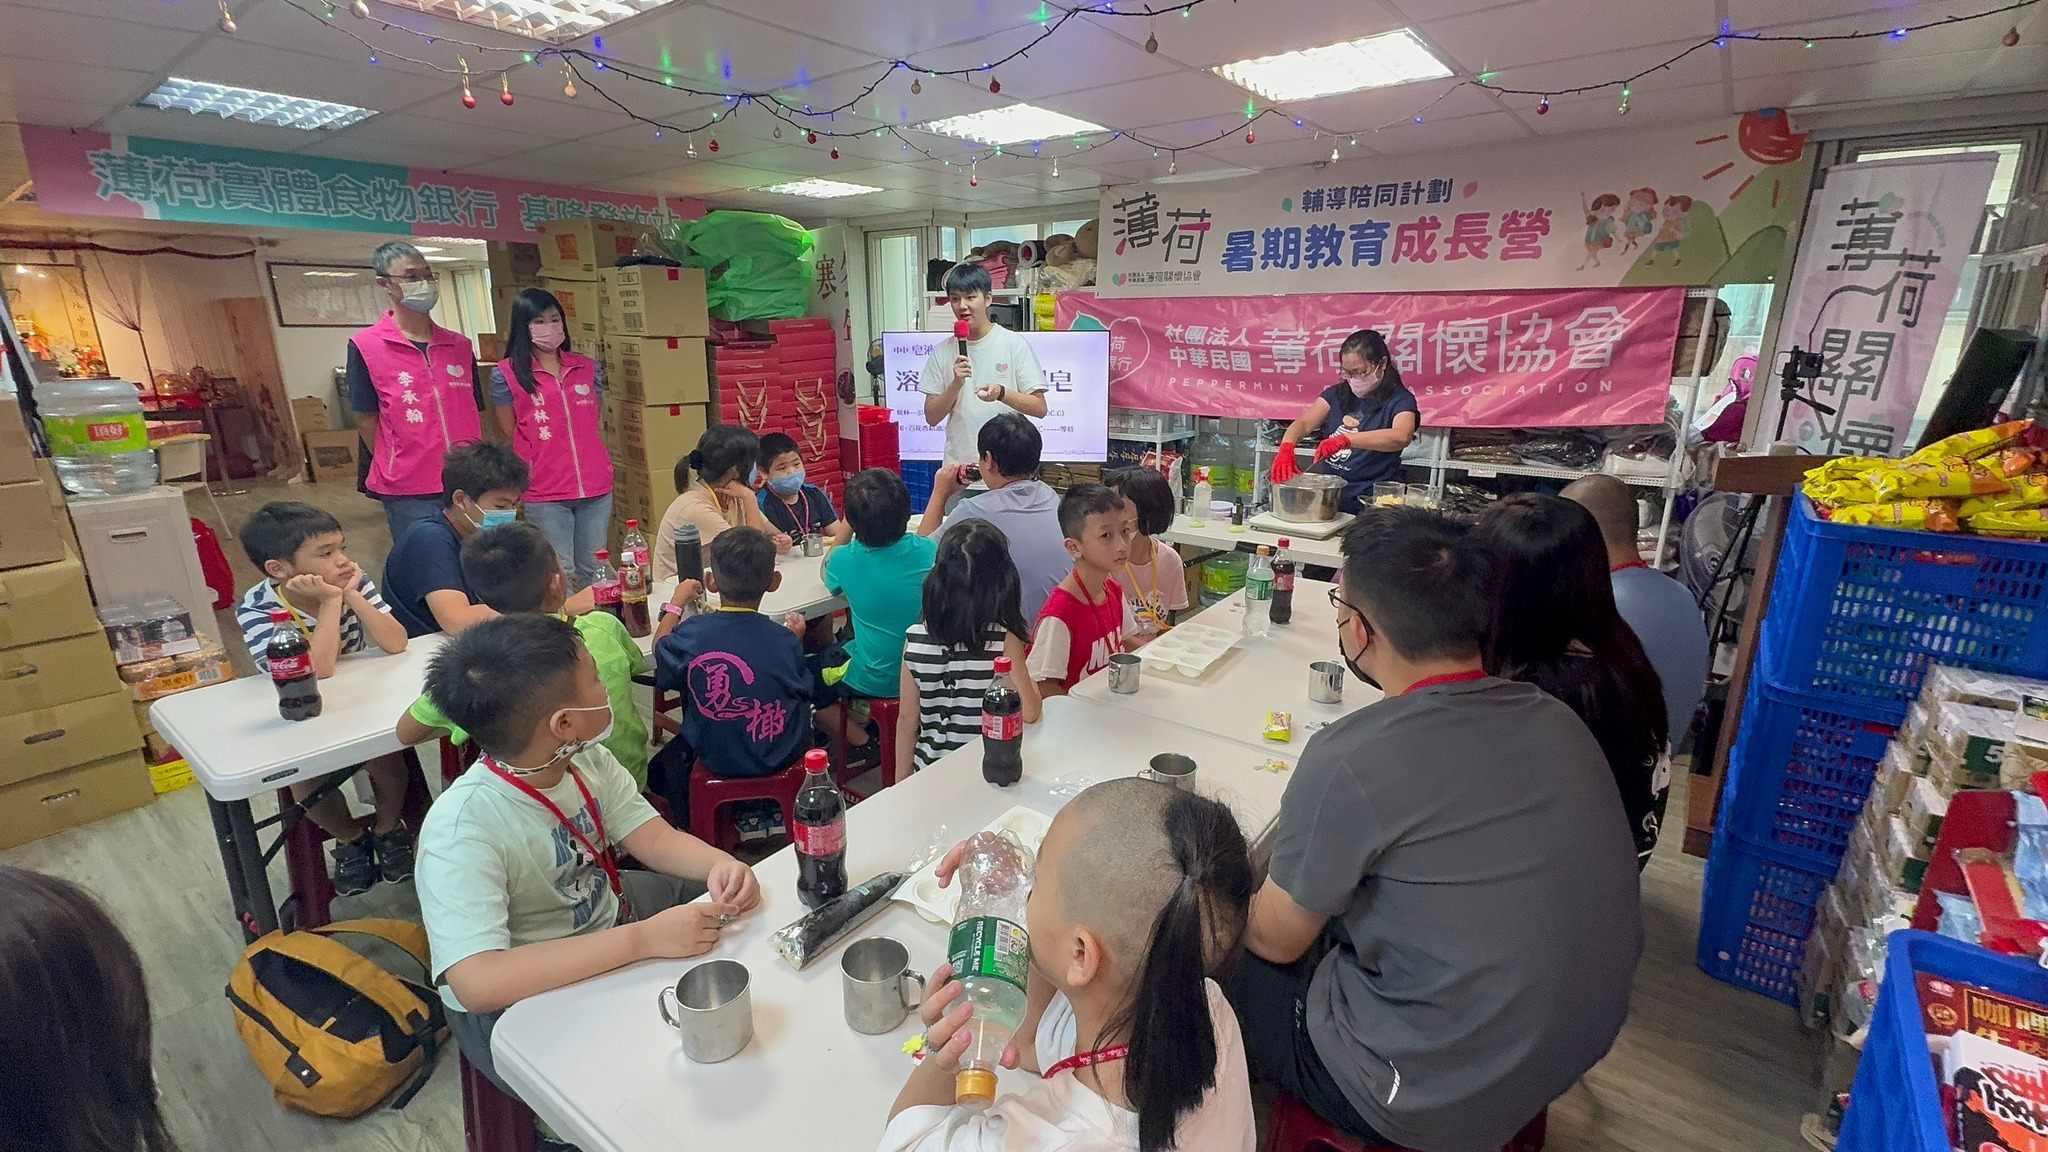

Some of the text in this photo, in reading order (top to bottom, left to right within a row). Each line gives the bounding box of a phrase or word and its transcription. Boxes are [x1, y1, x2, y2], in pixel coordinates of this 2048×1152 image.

[86, 150, 497, 230] 薄荷實體食物銀行
[1301, 178, 1454, 214] 輔導陪同計劃
[1112, 191, 1212, 265] 薄荷
[1220, 207, 1553, 273] 暑期教育成長營
[1164, 323, 1251, 347] 社團法人
[1169, 349, 1253, 373] 中華民國
[1168, 377, 1305, 393] PEPPERMINT
[1407, 380, 1614, 397] ASSOCIATION
[971, 920, 984, 971] RECYCLE ME
